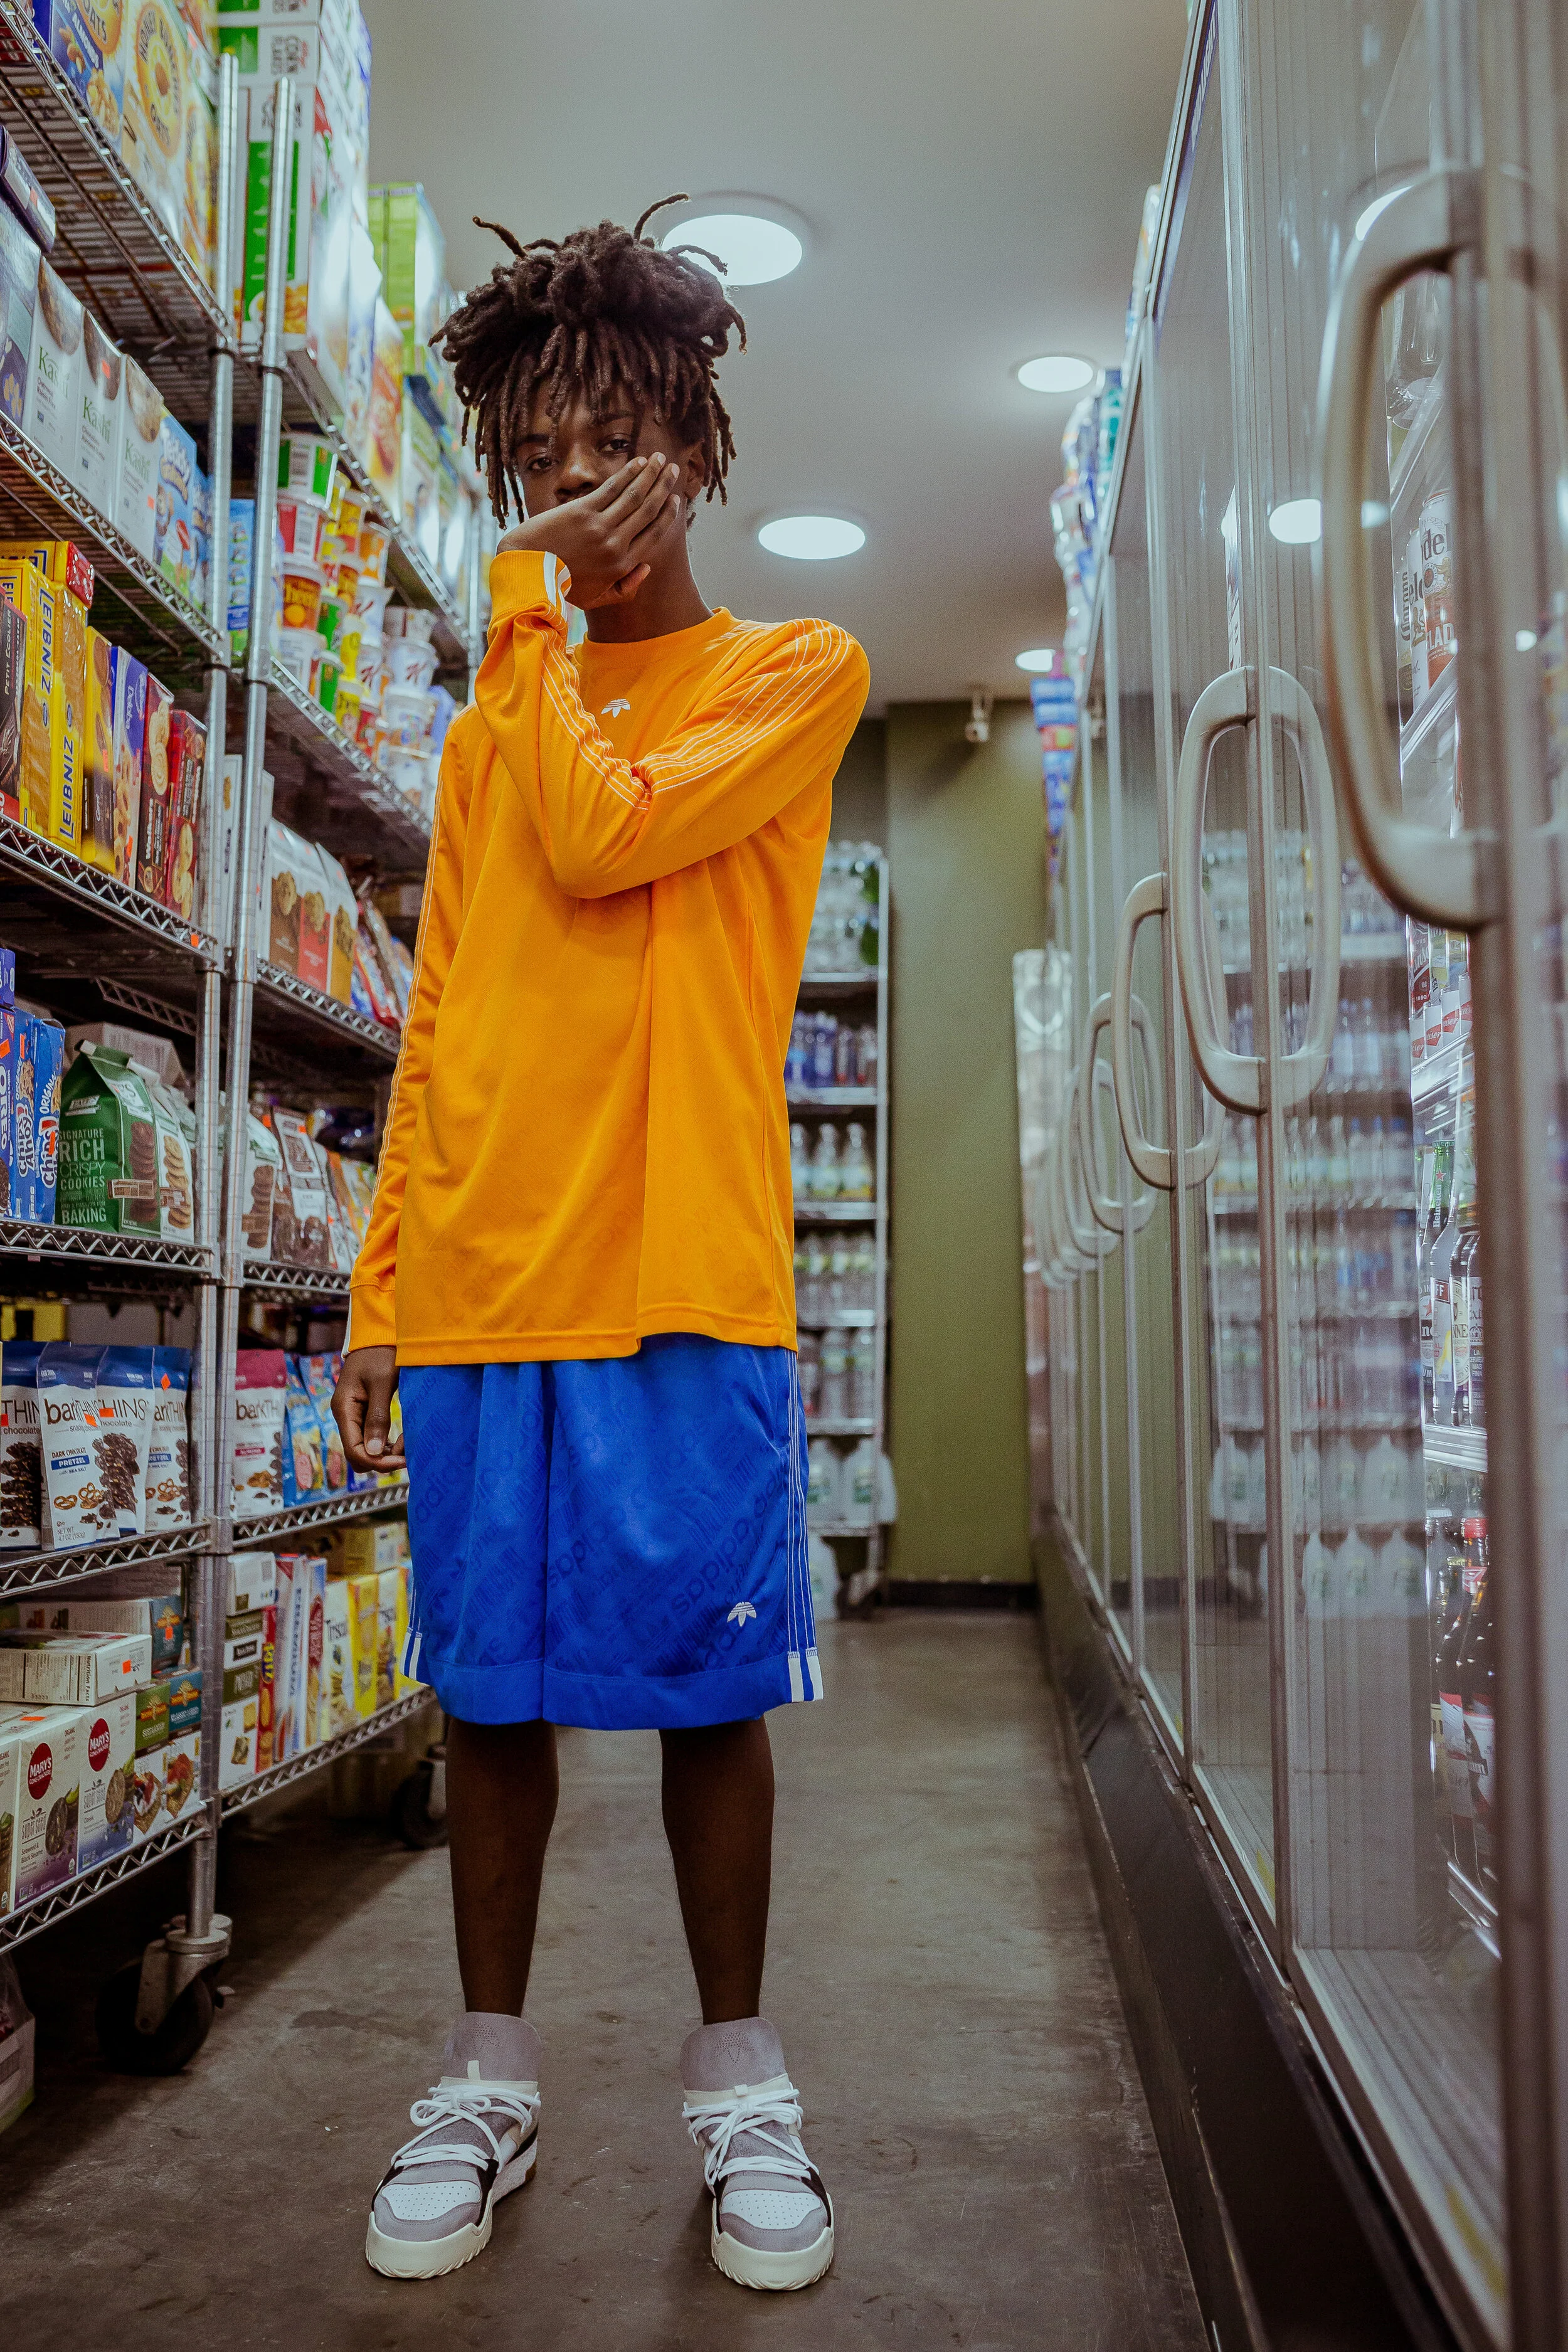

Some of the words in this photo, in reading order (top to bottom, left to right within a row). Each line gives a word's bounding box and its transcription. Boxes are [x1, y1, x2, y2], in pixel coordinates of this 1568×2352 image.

[38, 345, 70, 400] Kasi
[83, 396, 111, 443] Kashi
[39, 588, 55, 694] LEIBNIZ
[59, 736, 74, 839] LEIBNIZ
[23, 1116, 34, 1170] Ahoy
[59, 1128, 104, 1140] SIGNATURE
[17, 1118, 28, 1174] Chips
[60, 1139, 105, 1162] RICH
[60, 1162, 105, 1178] CRISPY
[61, 1176, 105, 1190] COOKIES
[63, 1208, 107, 1224] BAKING
[1433, 1184, 1442, 1228] Heineken
[66, 1446, 87, 1456] CHOCOLATE
[58, 1458, 86, 1468] PRETZEL
[90, 1731, 109, 1751] MARY'S
[30, 1757, 51, 1779] MARY'S
